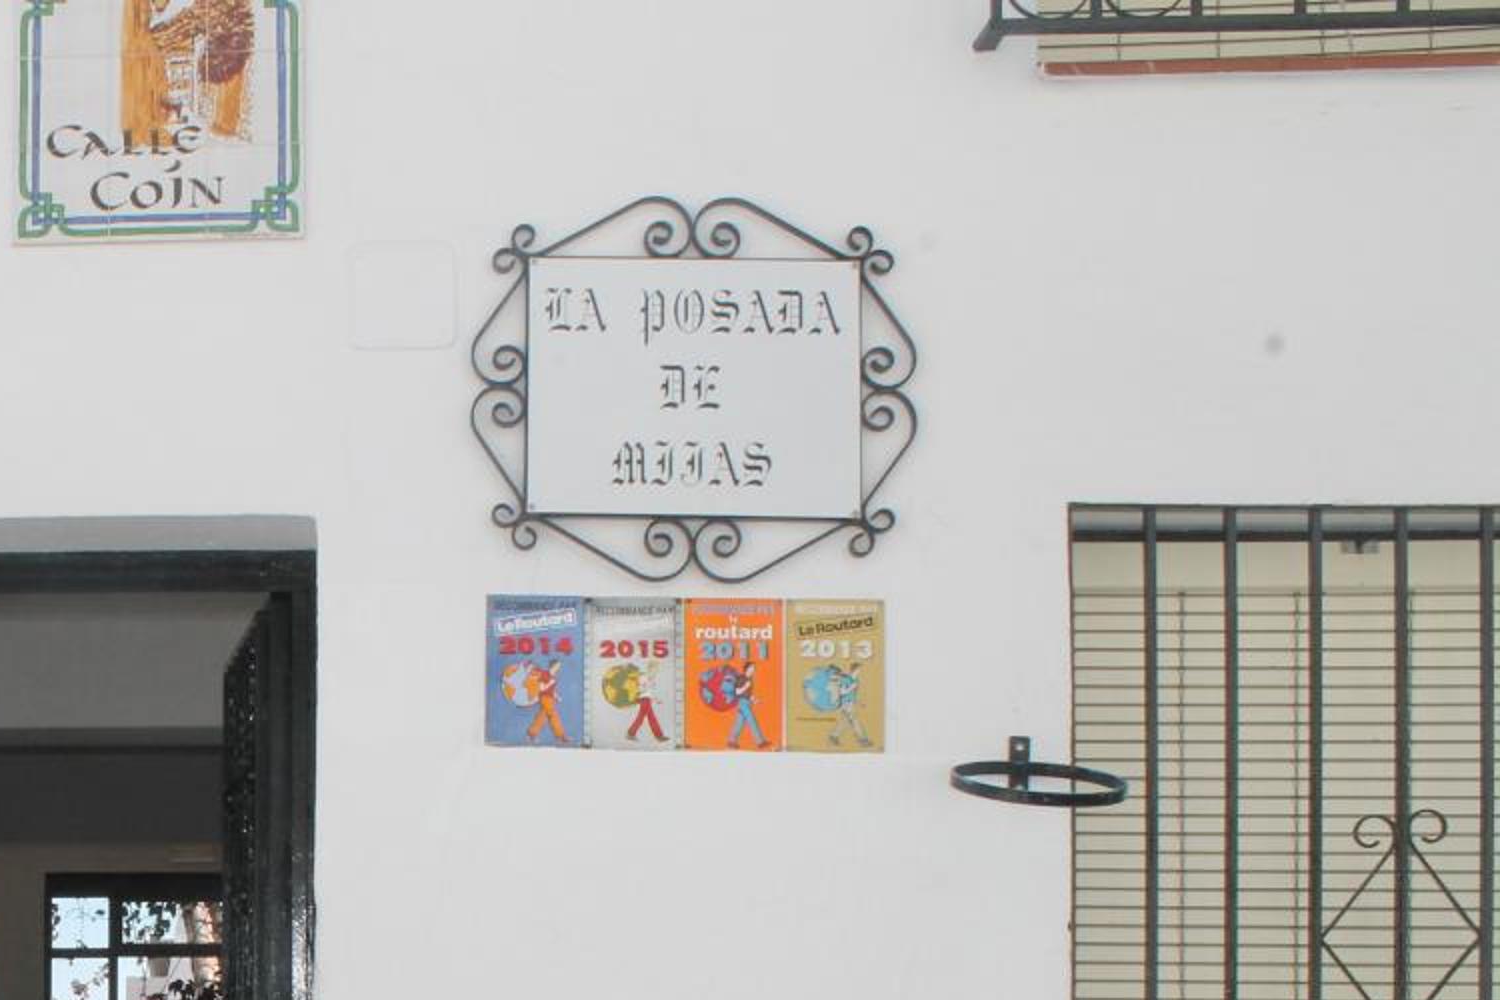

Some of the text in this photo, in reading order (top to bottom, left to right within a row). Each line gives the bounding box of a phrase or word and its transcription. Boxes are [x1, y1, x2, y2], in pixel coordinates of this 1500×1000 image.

[46, 125, 202, 160] CALLE
[544, 287, 842, 346] LA POSADA
[659, 365, 721, 409] DE
[611, 441, 773, 487] MIJAS
[695, 624, 773, 639] routard
[498, 635, 574, 656] 2014
[599, 639, 669, 658] 2015
[702, 640, 769, 660] 2011
[801, 640, 873, 659] 2013
